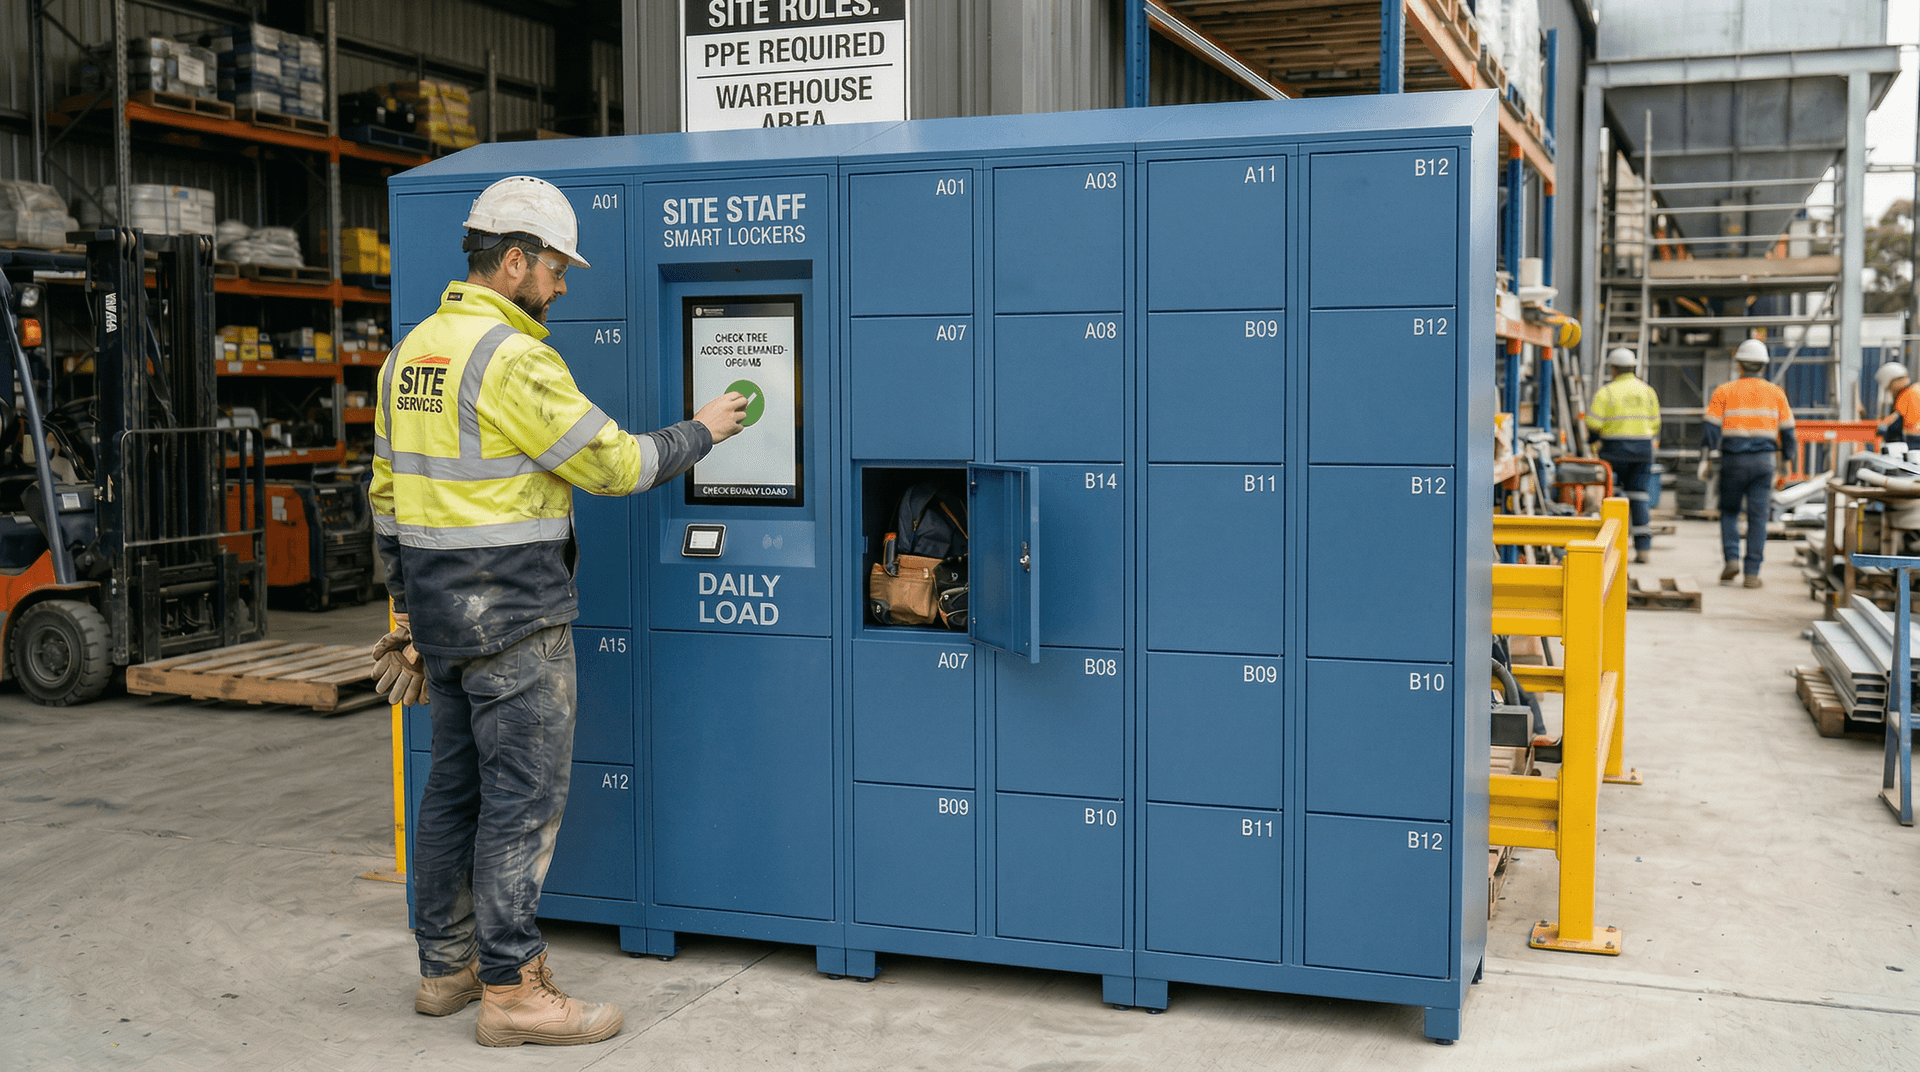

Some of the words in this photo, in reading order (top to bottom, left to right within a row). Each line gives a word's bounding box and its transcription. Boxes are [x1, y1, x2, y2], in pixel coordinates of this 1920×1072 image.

[708, 0, 770, 28] SITE
[704, 41, 751, 67] PPE
[759, 31, 885, 64] REQUIRED
[716, 76, 873, 109] WAREHOUSE
[1244, 164, 1275, 184] A11
[1414, 157, 1449, 177] B12
[935, 178, 964, 196] A01
[1084, 171, 1117, 190] A03
[592, 193, 618, 210] A01
[663, 198, 719, 226] SITE
[726, 193, 806, 223] STAFF
[663, 228, 723, 248] SMART
[728, 224, 806, 246] LOCKERS
[936, 324, 967, 342] A07
[1084, 321, 1117, 339] A08
[1245, 319, 1278, 338] B09
[1413, 317, 1448, 336] B12
[594, 328, 622, 345] A15
[715, 333, 744, 343] CHECK
[746, 333, 768, 342] TREE
[700, 346, 734, 356] ACCESS
[399, 366, 447, 396] SITE
[1085, 472, 1118, 490] B14
[1244, 474, 1275, 492] B11
[1411, 476, 1446, 495] B12
[699, 572, 781, 598] DAILY
[699, 600, 779, 626] LOAD
[598, 636, 627, 654] A15
[937, 652, 969, 670] A07
[1085, 658, 1117, 676] B08
[1243, 664, 1277, 684] B09
[1409, 672, 1445, 692] B10
[601, 773, 629, 790] A12
[938, 797, 969, 816] B09
[1085, 807, 1117, 827] B10
[1242, 818, 1272, 838] B11
[1408, 830, 1443, 851] B12
